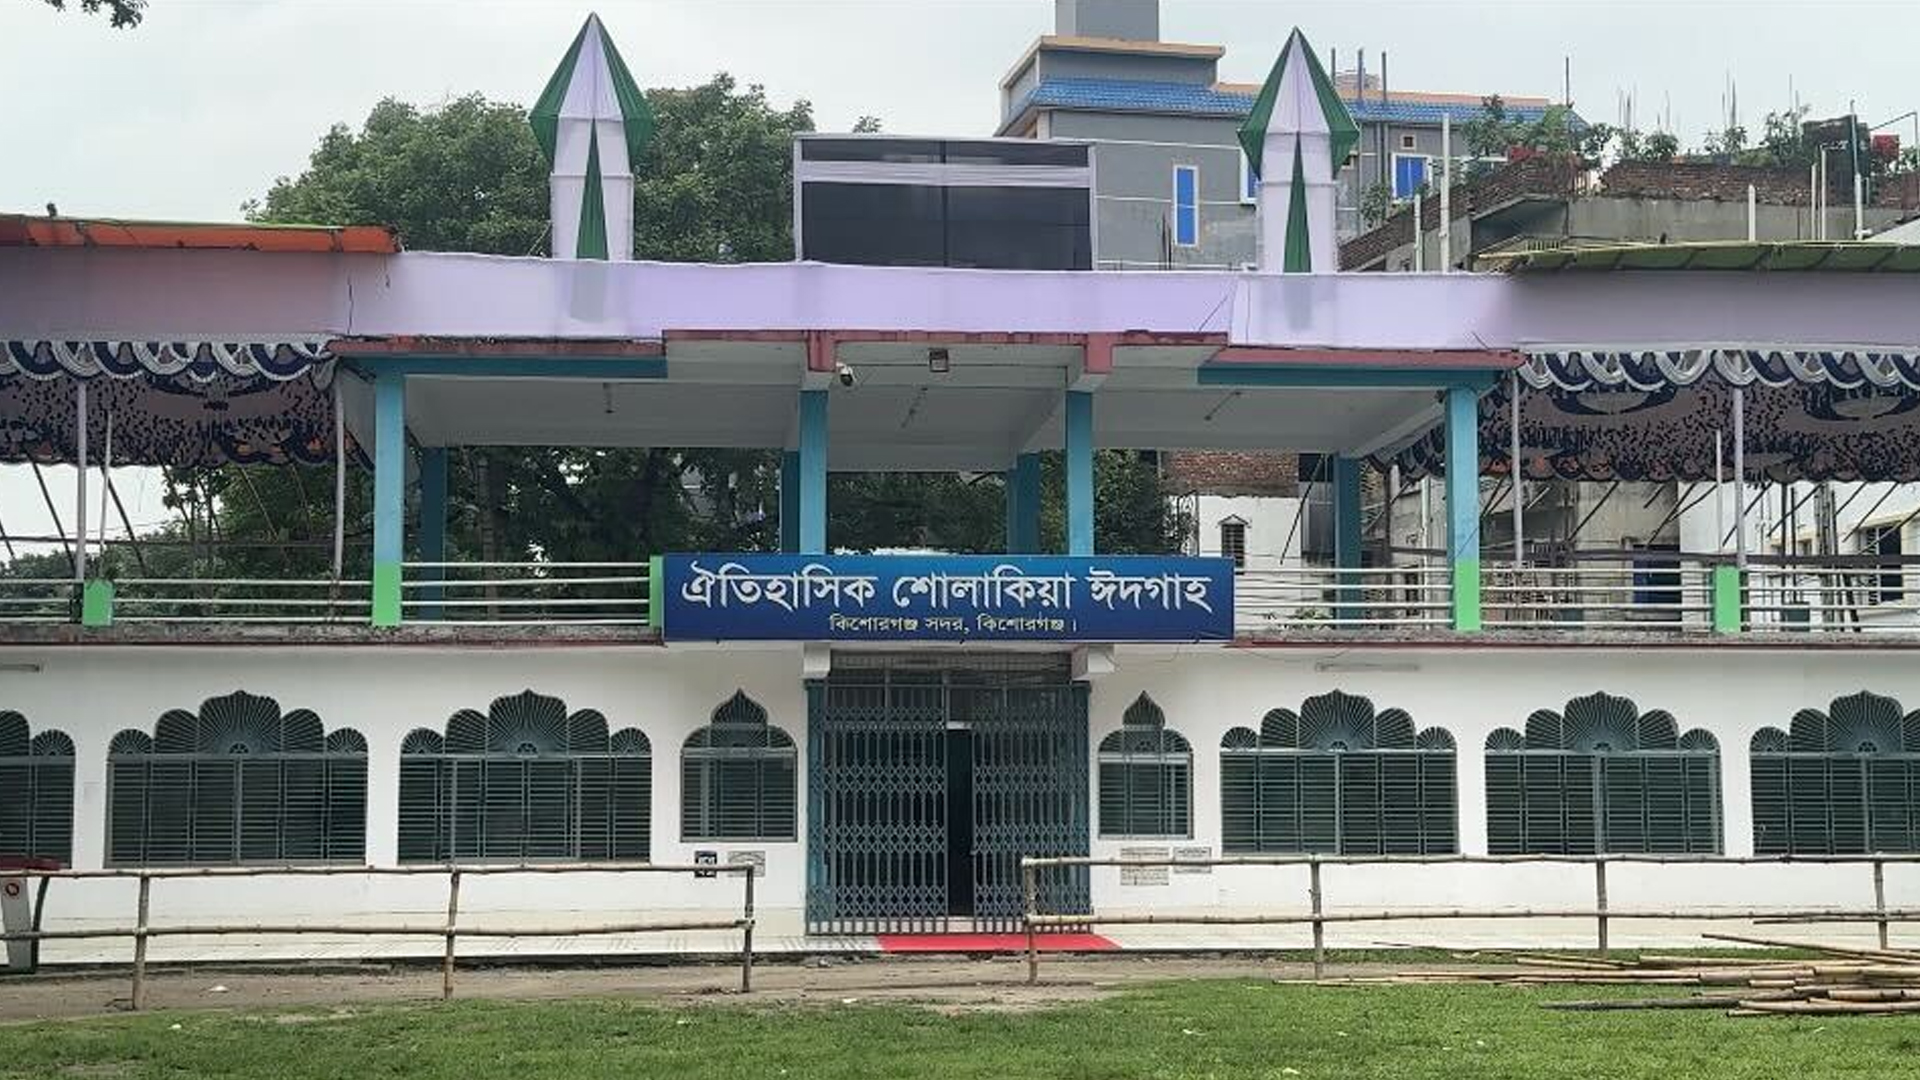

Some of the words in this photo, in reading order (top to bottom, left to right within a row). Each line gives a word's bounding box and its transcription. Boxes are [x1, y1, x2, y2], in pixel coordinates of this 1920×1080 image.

[681, 561, 878, 610] ঐতিহাসিক
[892, 563, 1076, 610] শোলাকিয়া
[1085, 565, 1212, 611] ঈদগাহ
[829, 613, 917, 632] কিশোরগঞ্জ
[925, 616, 969, 633] সদর,
